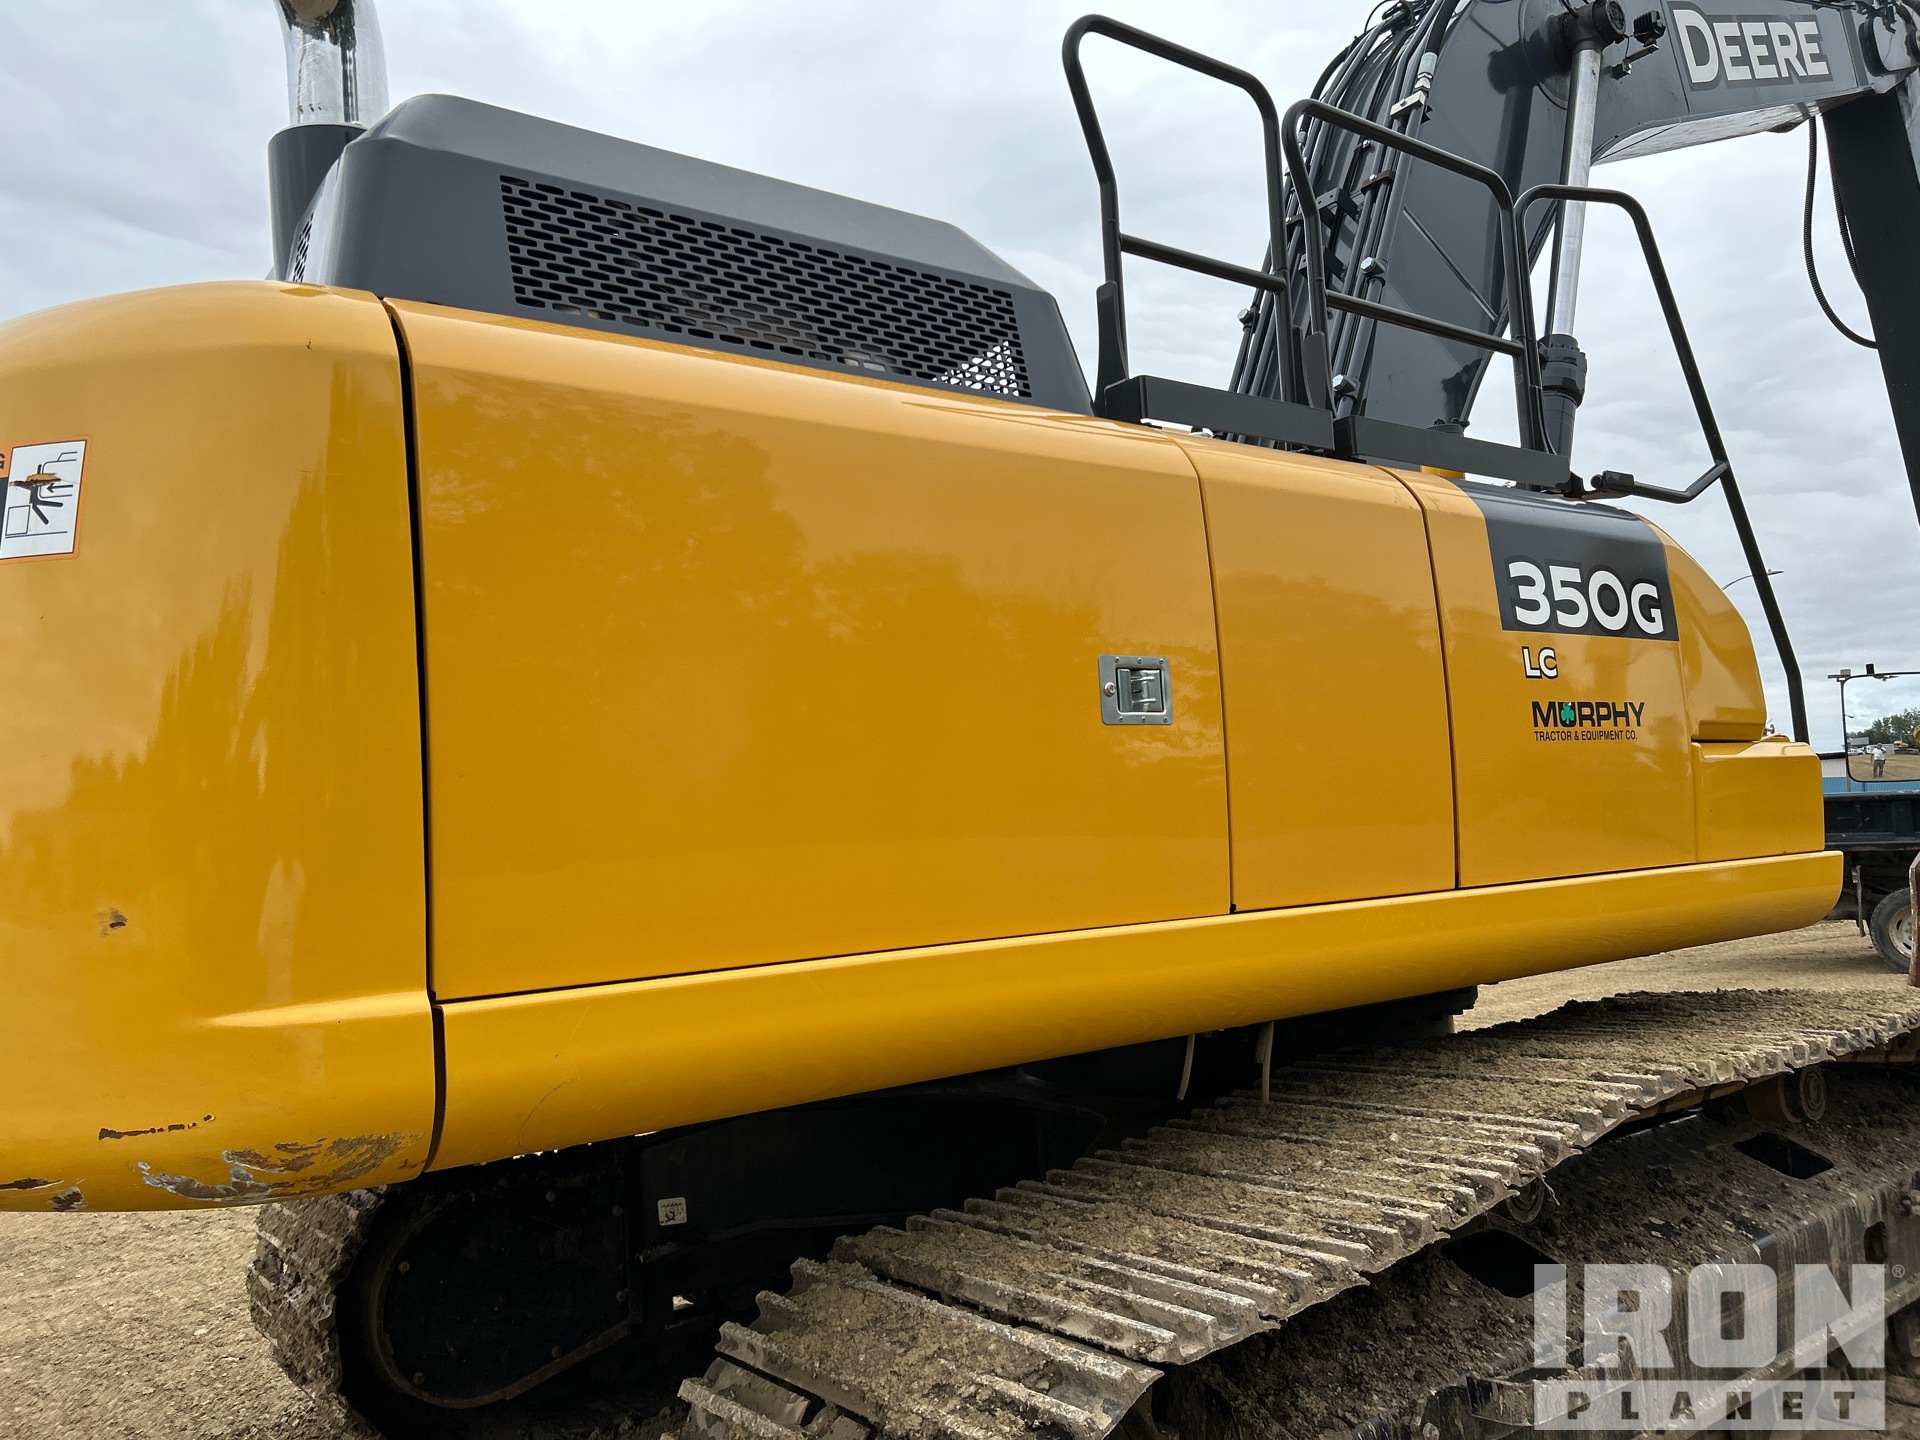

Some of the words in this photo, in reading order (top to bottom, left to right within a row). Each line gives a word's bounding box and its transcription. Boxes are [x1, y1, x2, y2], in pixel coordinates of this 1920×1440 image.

[1673, 9, 1829, 84] DEERE
[1508, 561, 1664, 635] 350G
[1522, 647, 1558, 679] LC
[1531, 700, 1645, 728] MURPHY
[1534, 730, 1572, 741] TRACTOR
[1574, 730, 1580, 741] &
[1581, 730, 1624, 741] EQUIPMENT
[1625, 729, 1638, 740] CO.
